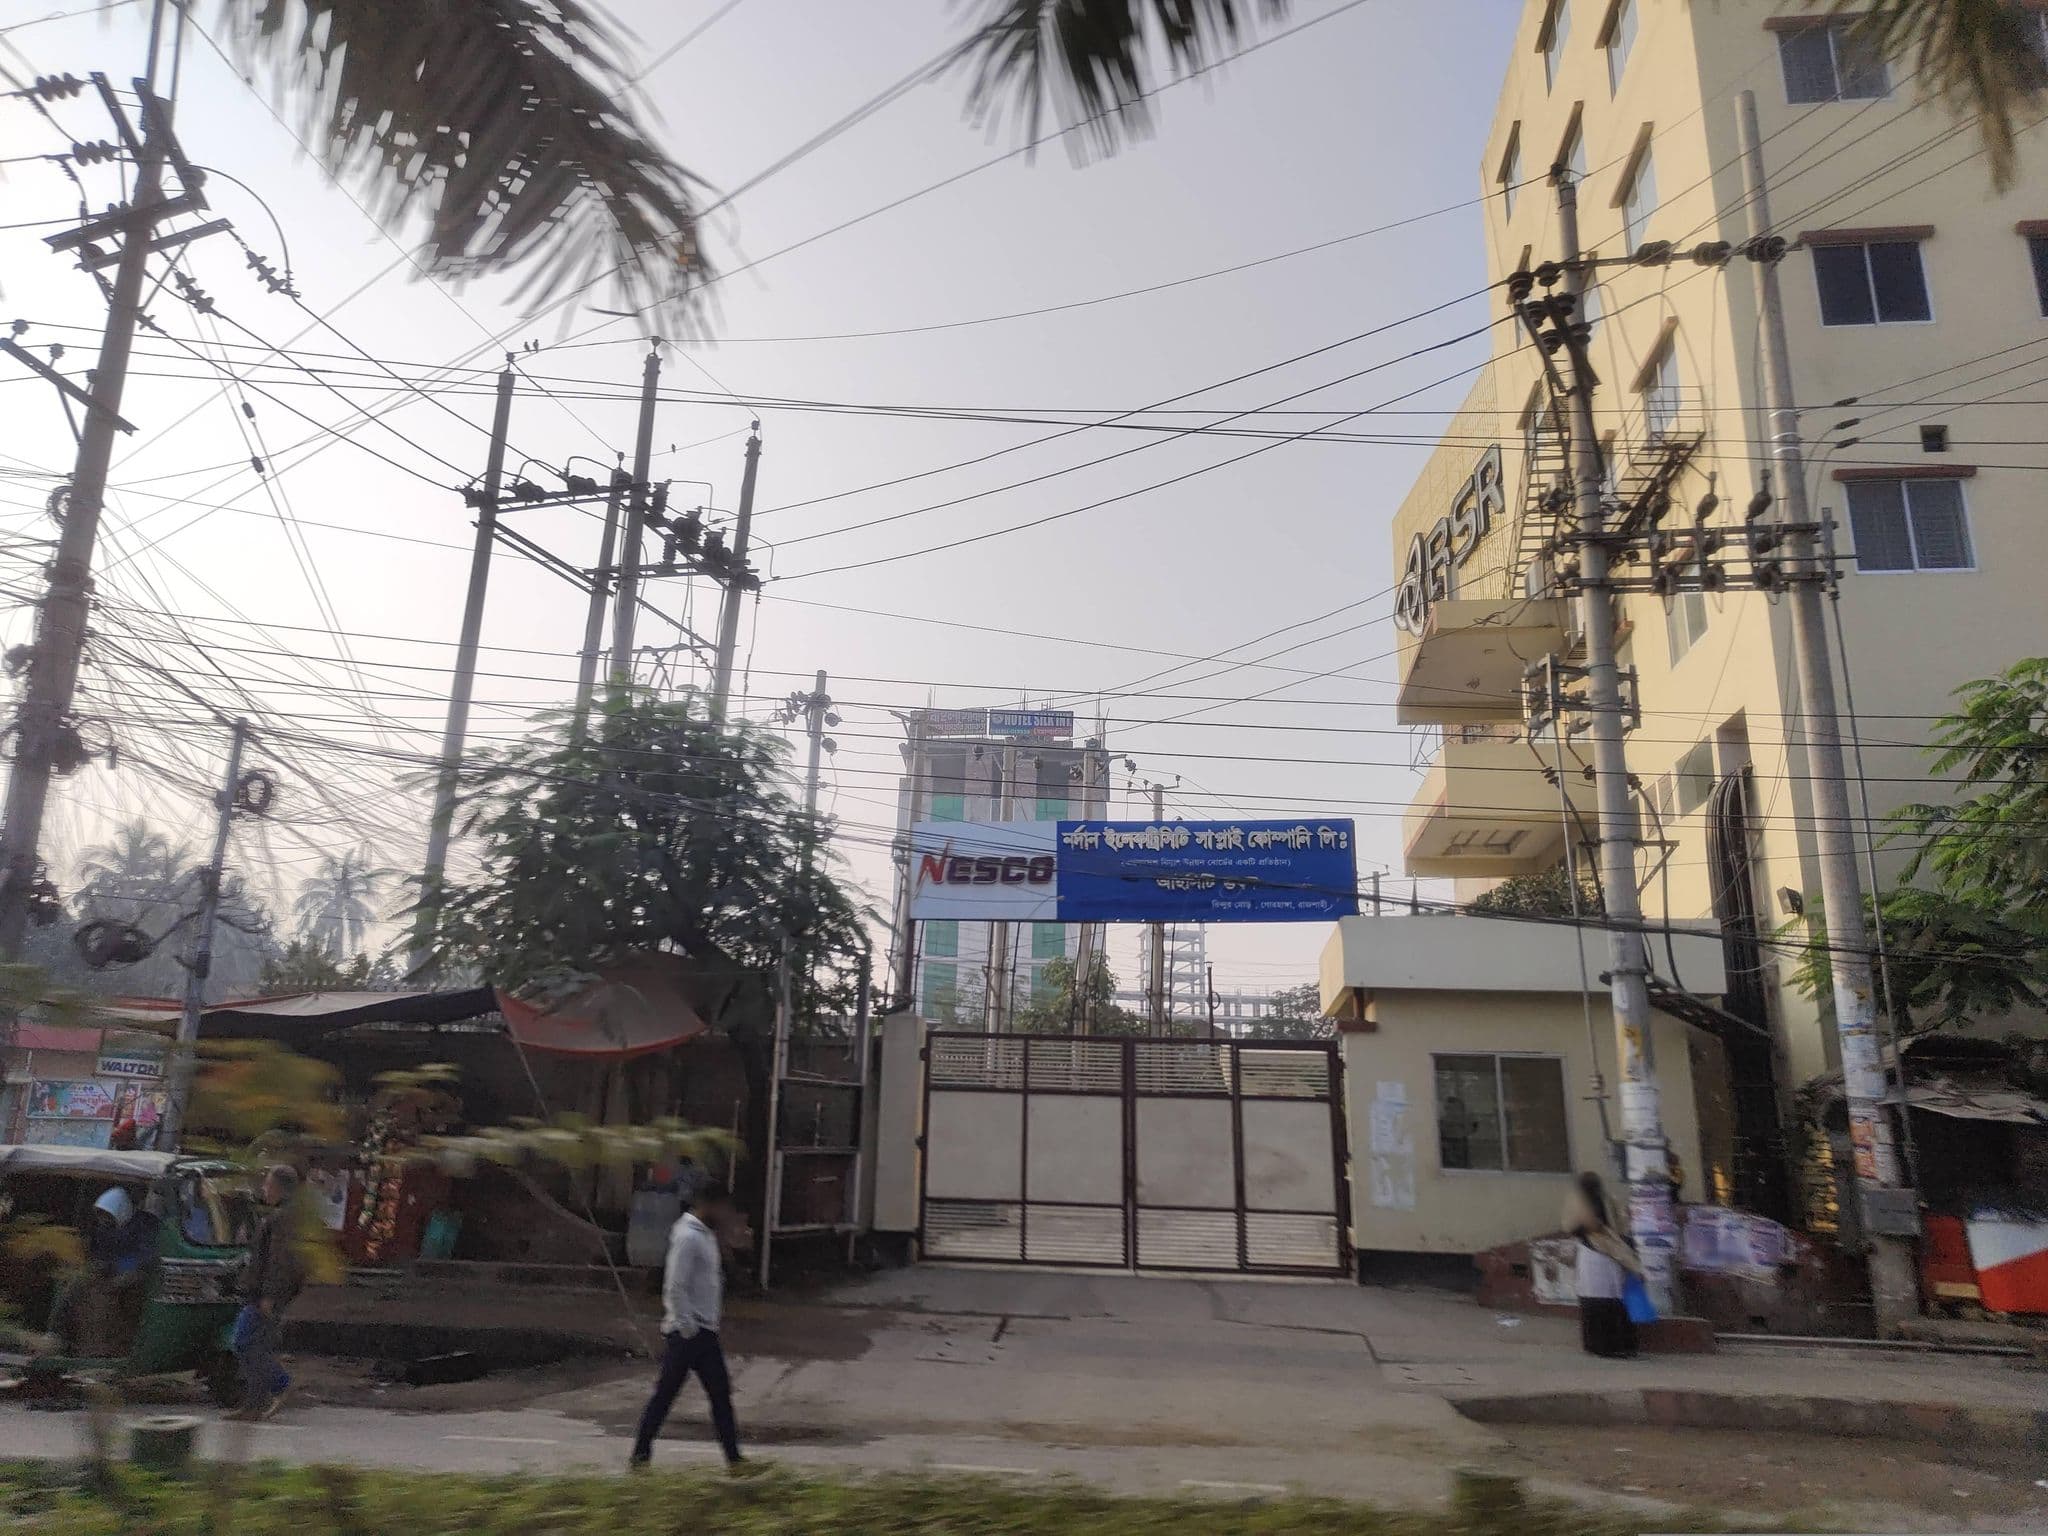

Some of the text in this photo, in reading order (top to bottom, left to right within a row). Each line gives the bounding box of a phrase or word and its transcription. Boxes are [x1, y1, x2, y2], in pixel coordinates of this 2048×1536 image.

[1004, 713, 1032, 726] HOTEL
[916, 839, 1054, 890] NESCO
[102, 1061, 159, 1075] WALTON
